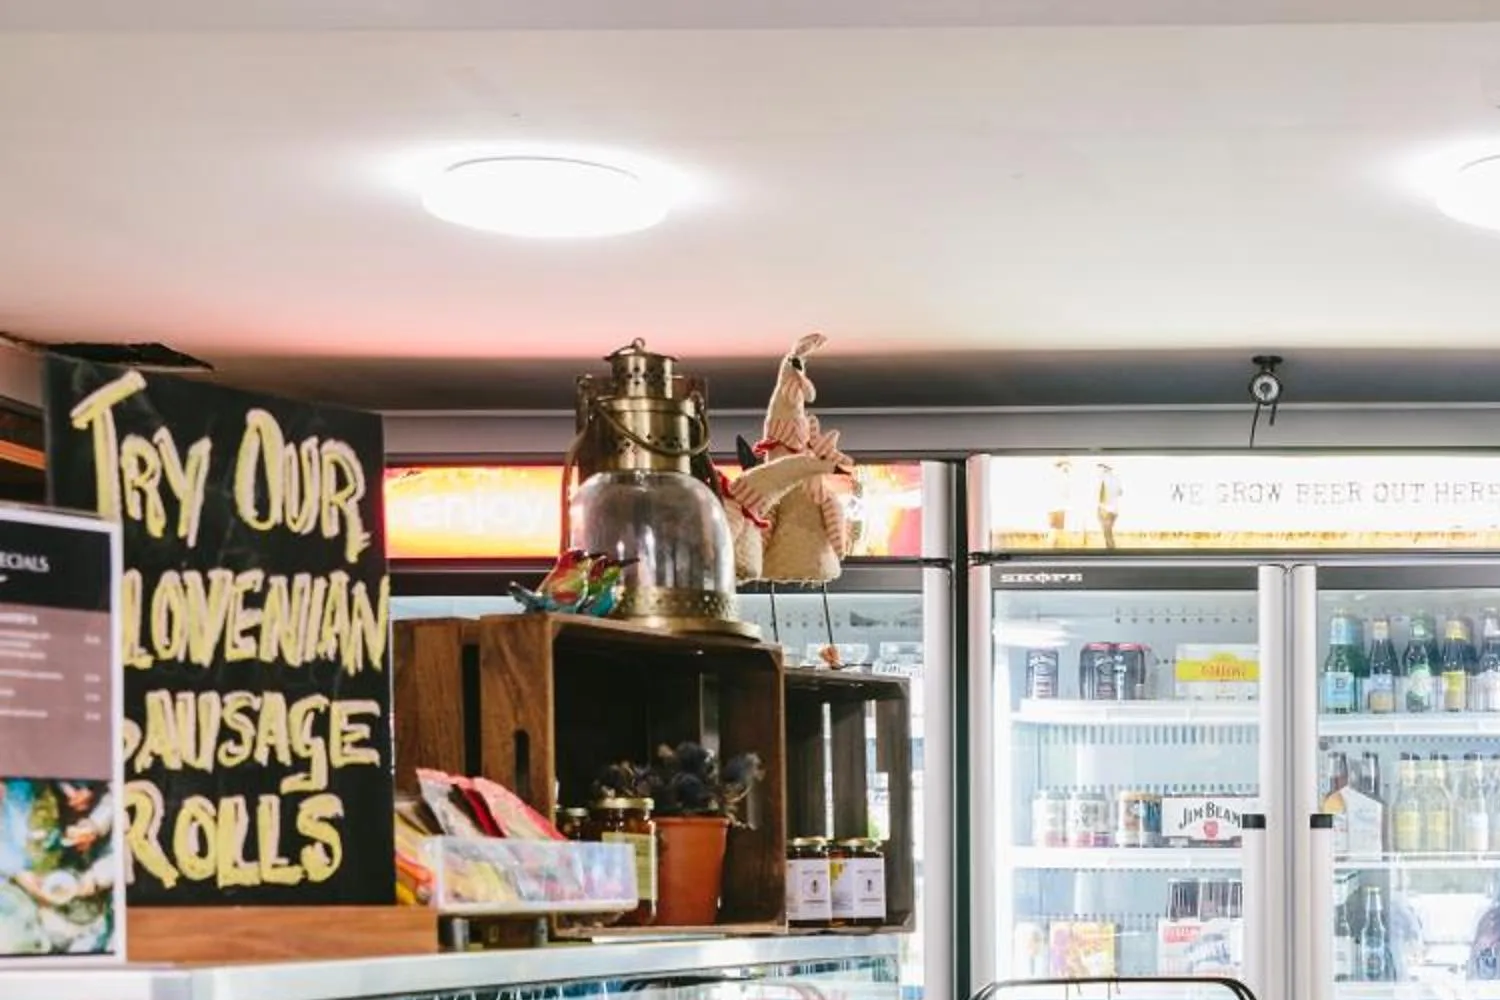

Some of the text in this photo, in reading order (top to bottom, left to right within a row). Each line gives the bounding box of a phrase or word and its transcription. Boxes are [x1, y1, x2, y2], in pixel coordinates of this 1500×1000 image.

[70, 371, 371, 562] TRY OUR
[1170, 482, 1204, 504] WE
[1215, 482, 1283, 504] GROW
[1296, 481, 1362, 504] BEER
[1373, 482, 1425, 503] OUT
[123, 568, 390, 677] LOVENIAN
[124, 780, 344, 889] ROLLS
[1179, 800, 1242, 829] JIM BEAM
